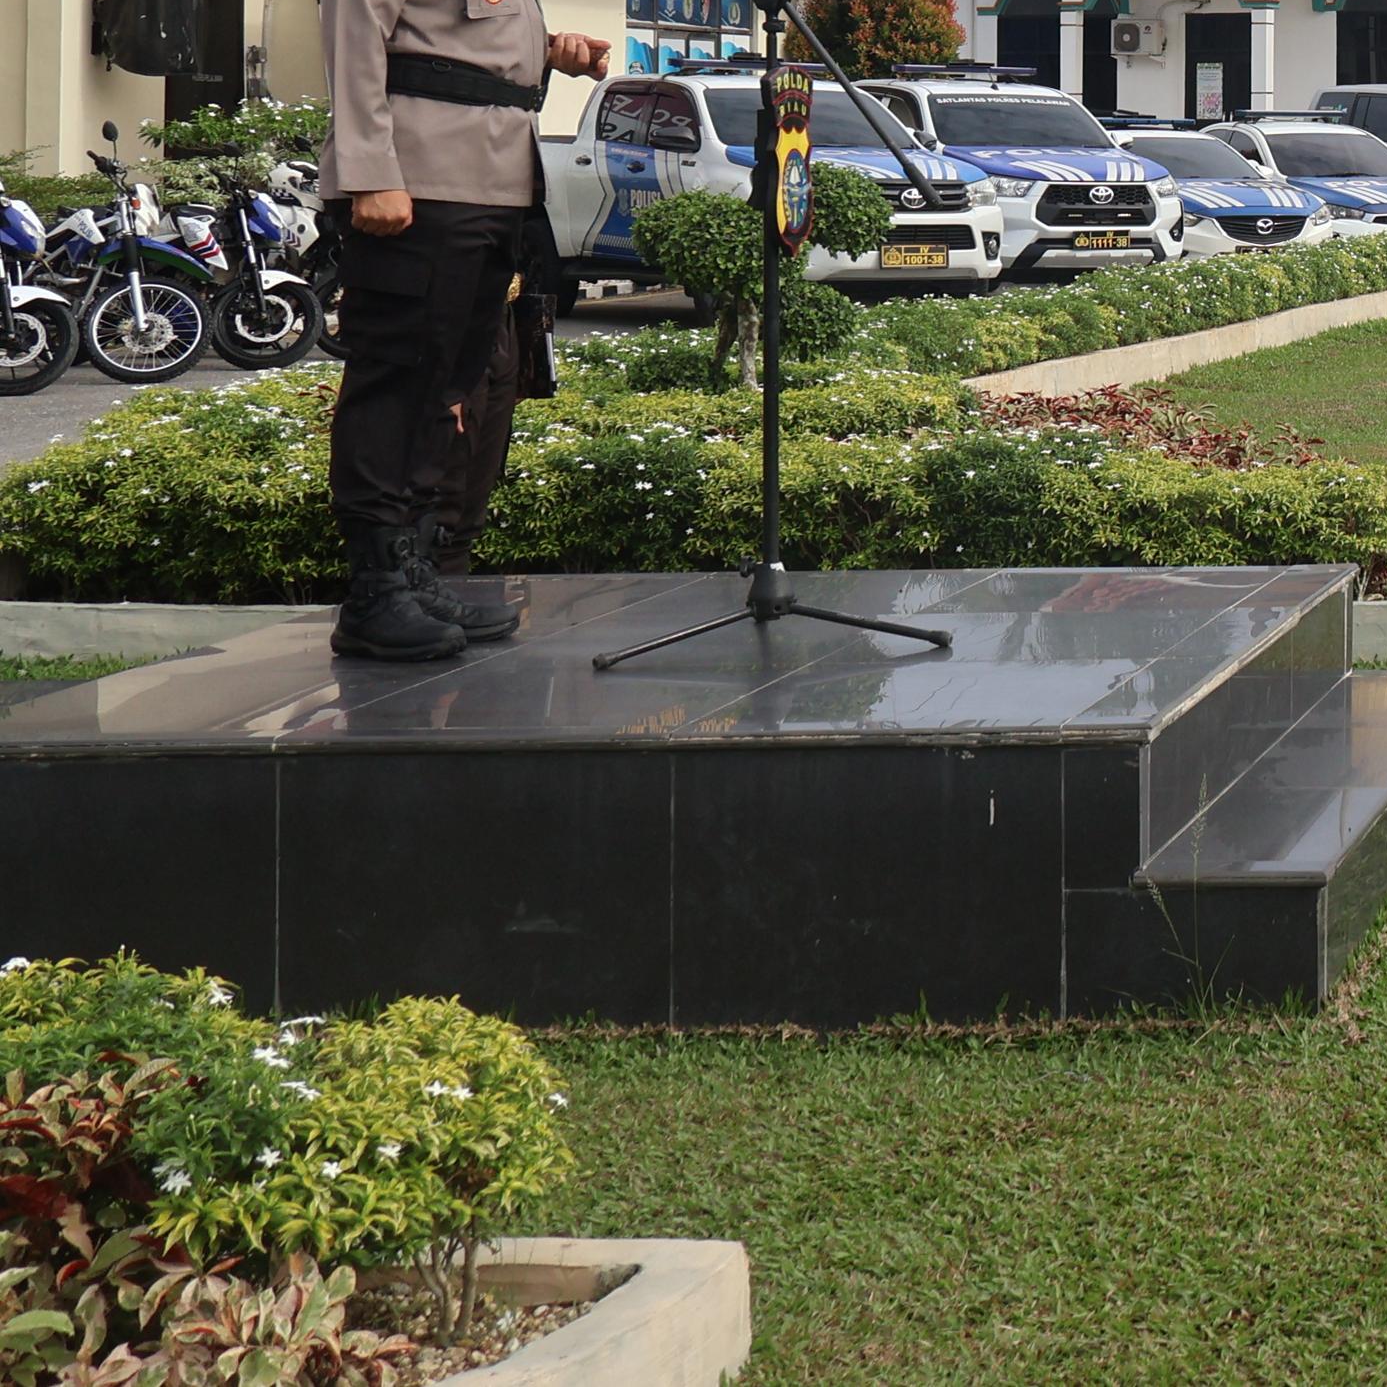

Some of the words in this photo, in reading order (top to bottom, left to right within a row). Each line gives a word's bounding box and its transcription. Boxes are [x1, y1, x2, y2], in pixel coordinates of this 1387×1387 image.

[776, 73, 809, 95] POLDA
[936, 97, 986, 105] SATLANTAS
[987, 97, 1020, 105] POLRES
[1021, 98, 1070, 107] PELALAWAN
[780, 101, 807, 117] RIAU
[1091, 238, 1128, 248] 1111-38
[904, 255, 944, 264] 1001-38
